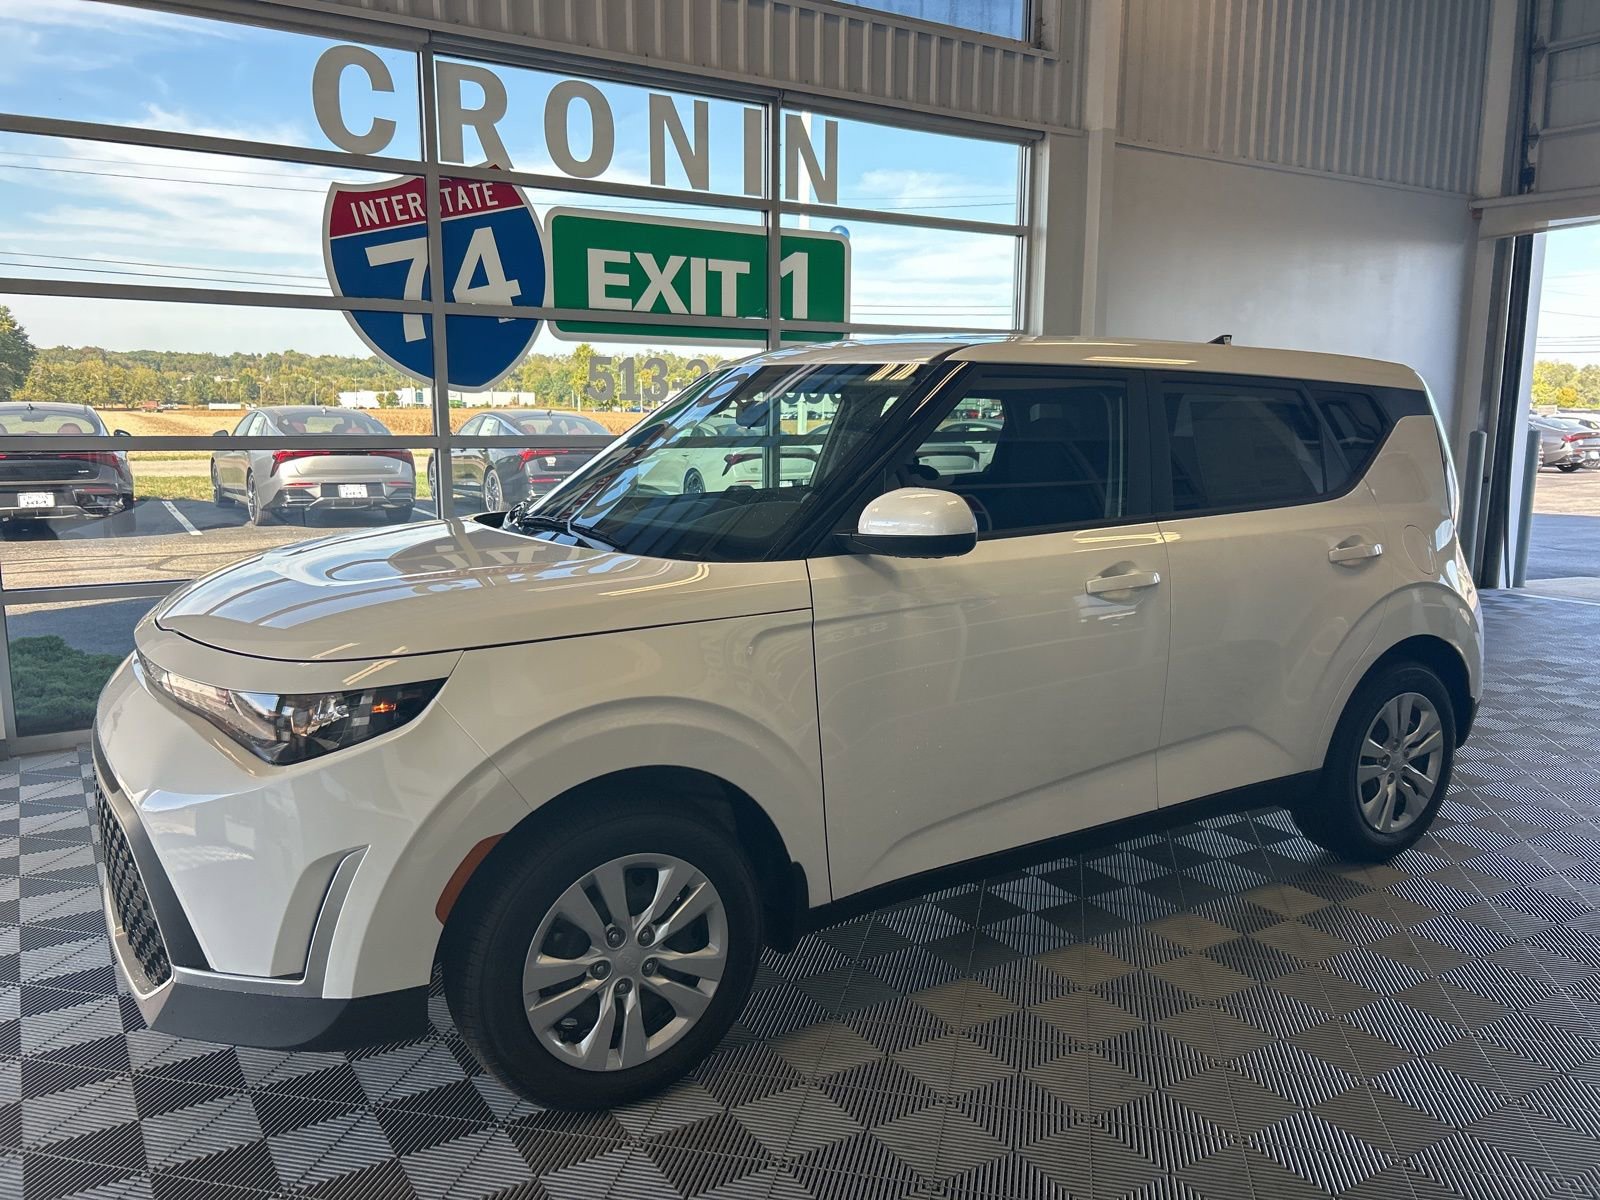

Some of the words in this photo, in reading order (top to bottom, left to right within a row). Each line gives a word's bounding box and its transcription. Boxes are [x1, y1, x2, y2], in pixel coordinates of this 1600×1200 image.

[312, 45, 838, 205] CRONIN
[350, 182, 498, 228] INTERTATE
[365, 226, 522, 342] 74
[587, 248, 750, 318] EXIT
[780, 252, 808, 319] 1
